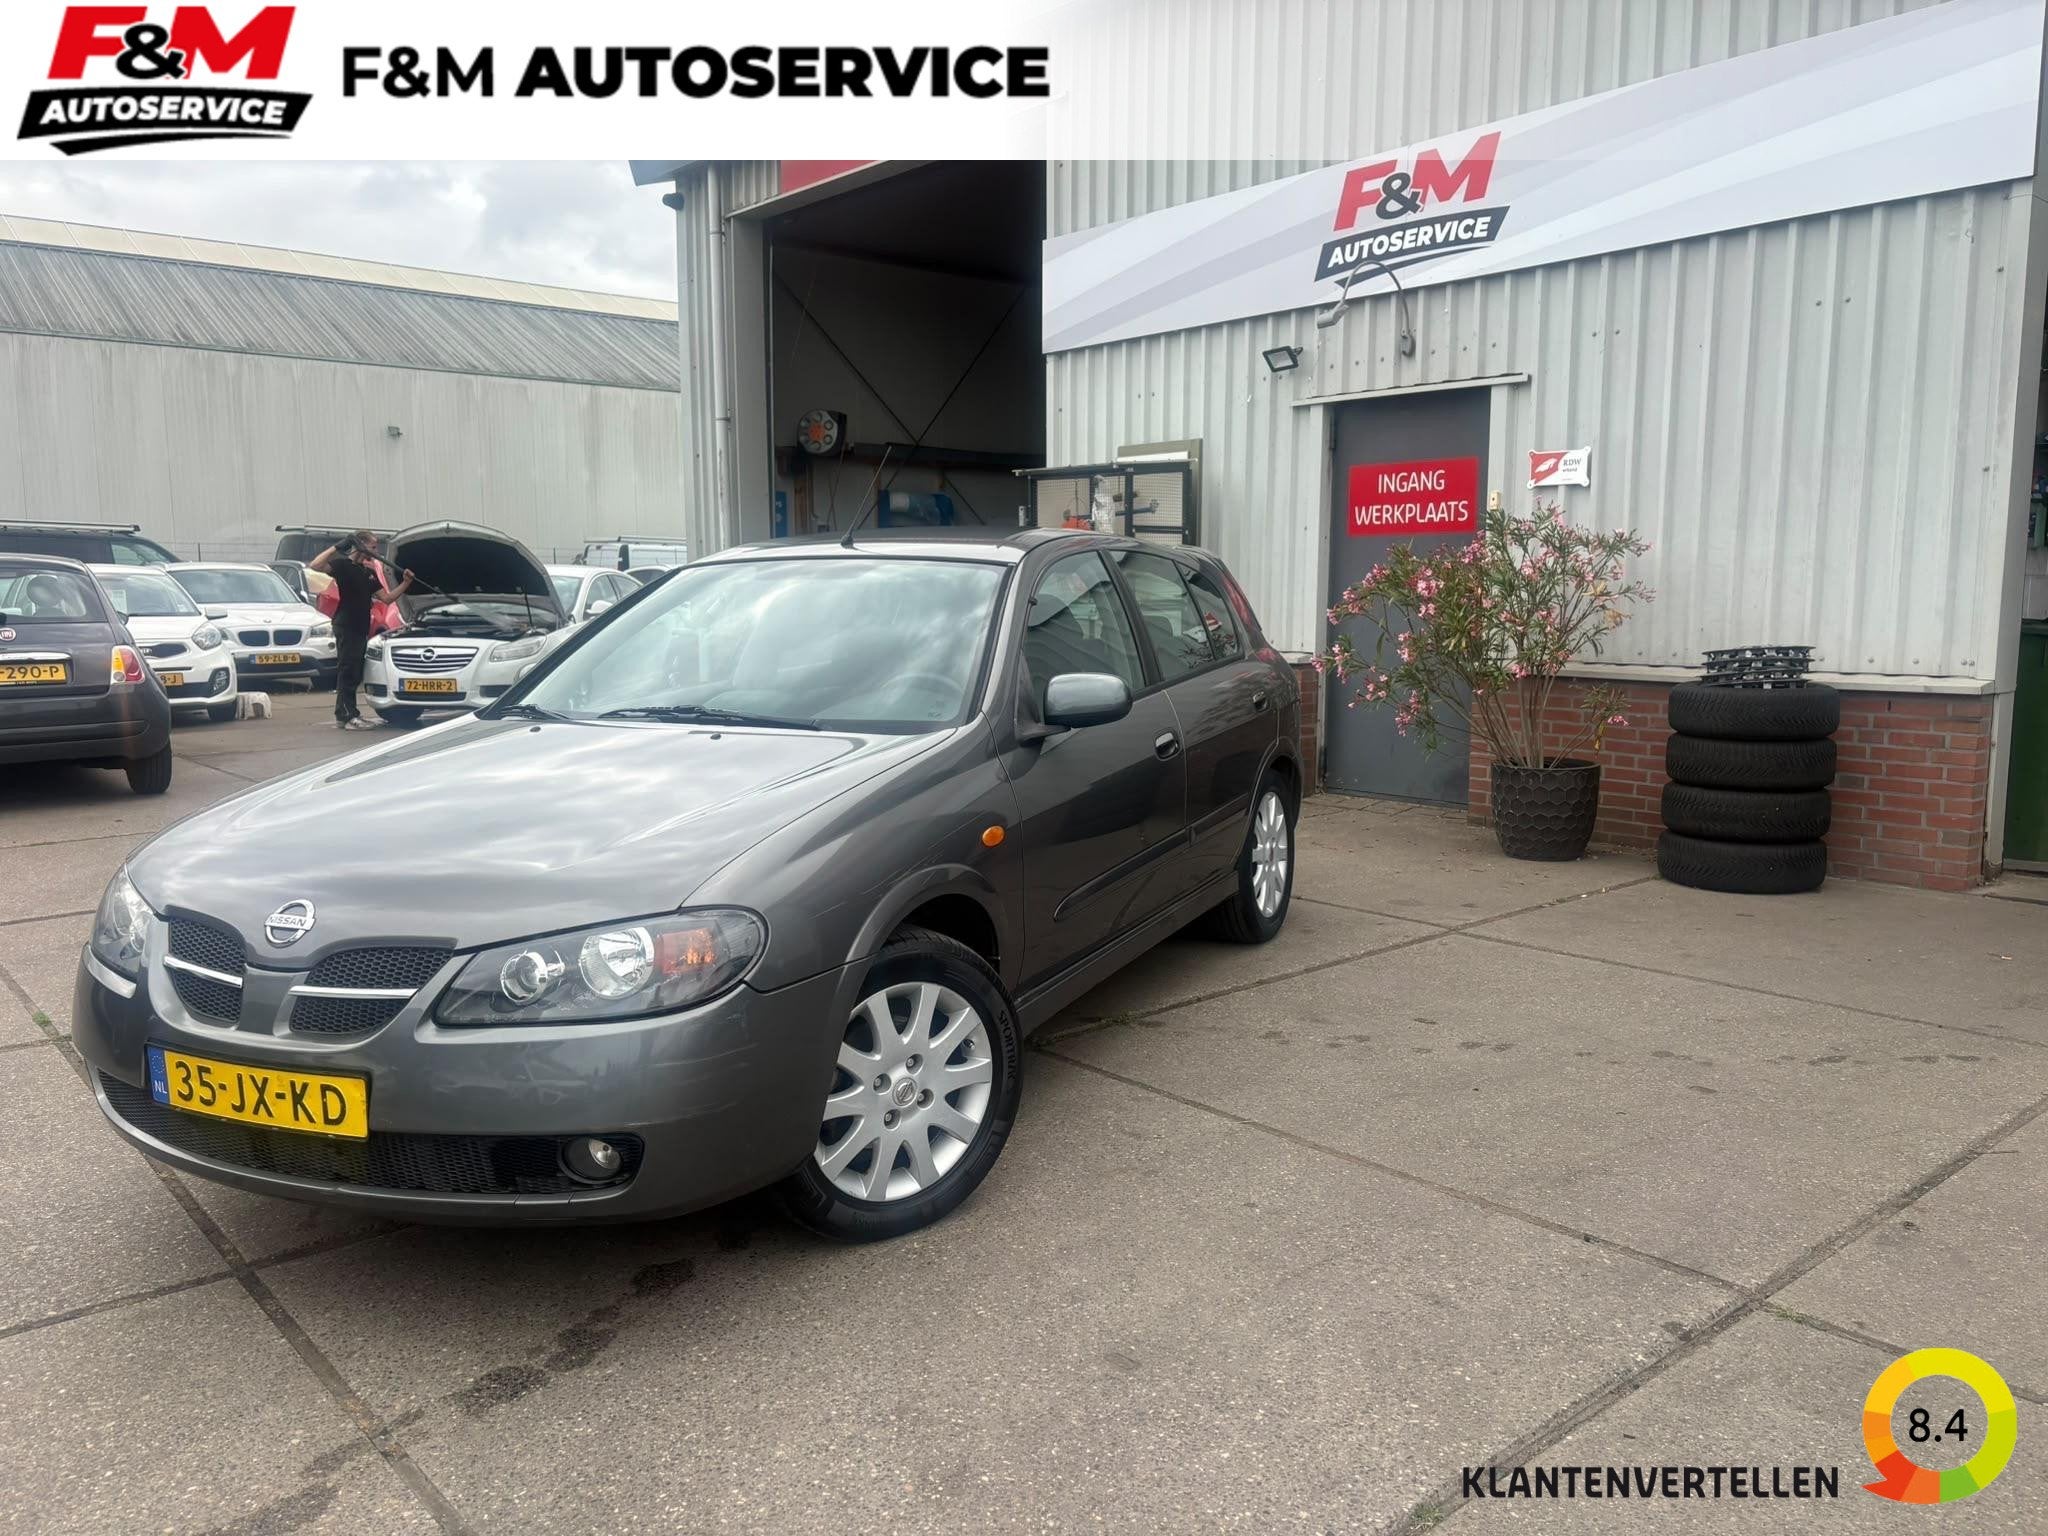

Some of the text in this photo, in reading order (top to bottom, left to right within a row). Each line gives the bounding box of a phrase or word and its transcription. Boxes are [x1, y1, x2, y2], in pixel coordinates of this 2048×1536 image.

[1333, 131, 1501, 232] F&M
[1327, 216, 1492, 269] AUTOSERVICE
[1378, 469, 1446, 495] INGANG
[1354, 500, 1469, 526] WERKPLAATS
[407, 680, 454, 691] 72-HRR-2
[270, 916, 307, 927] NISSAN
[154, 1060, 347, 1127] NL 35-JX-KD
